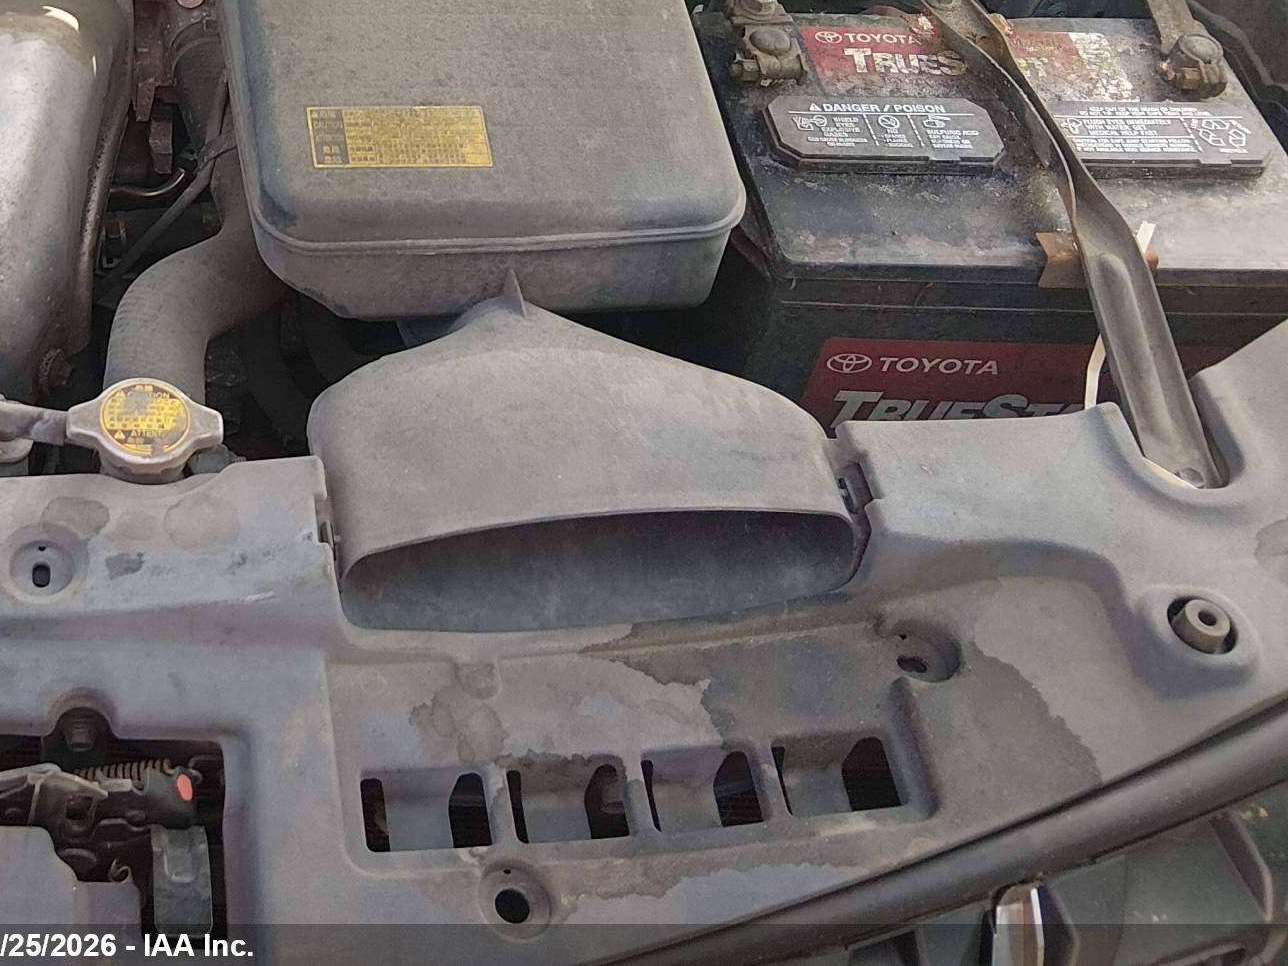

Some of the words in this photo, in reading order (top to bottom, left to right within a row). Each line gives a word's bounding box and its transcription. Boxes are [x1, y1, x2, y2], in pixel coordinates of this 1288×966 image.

[822, 103, 881, 112] DANGER
[893, 104, 946, 113] POISON
[879, 356, 999, 375] TOYOTA
